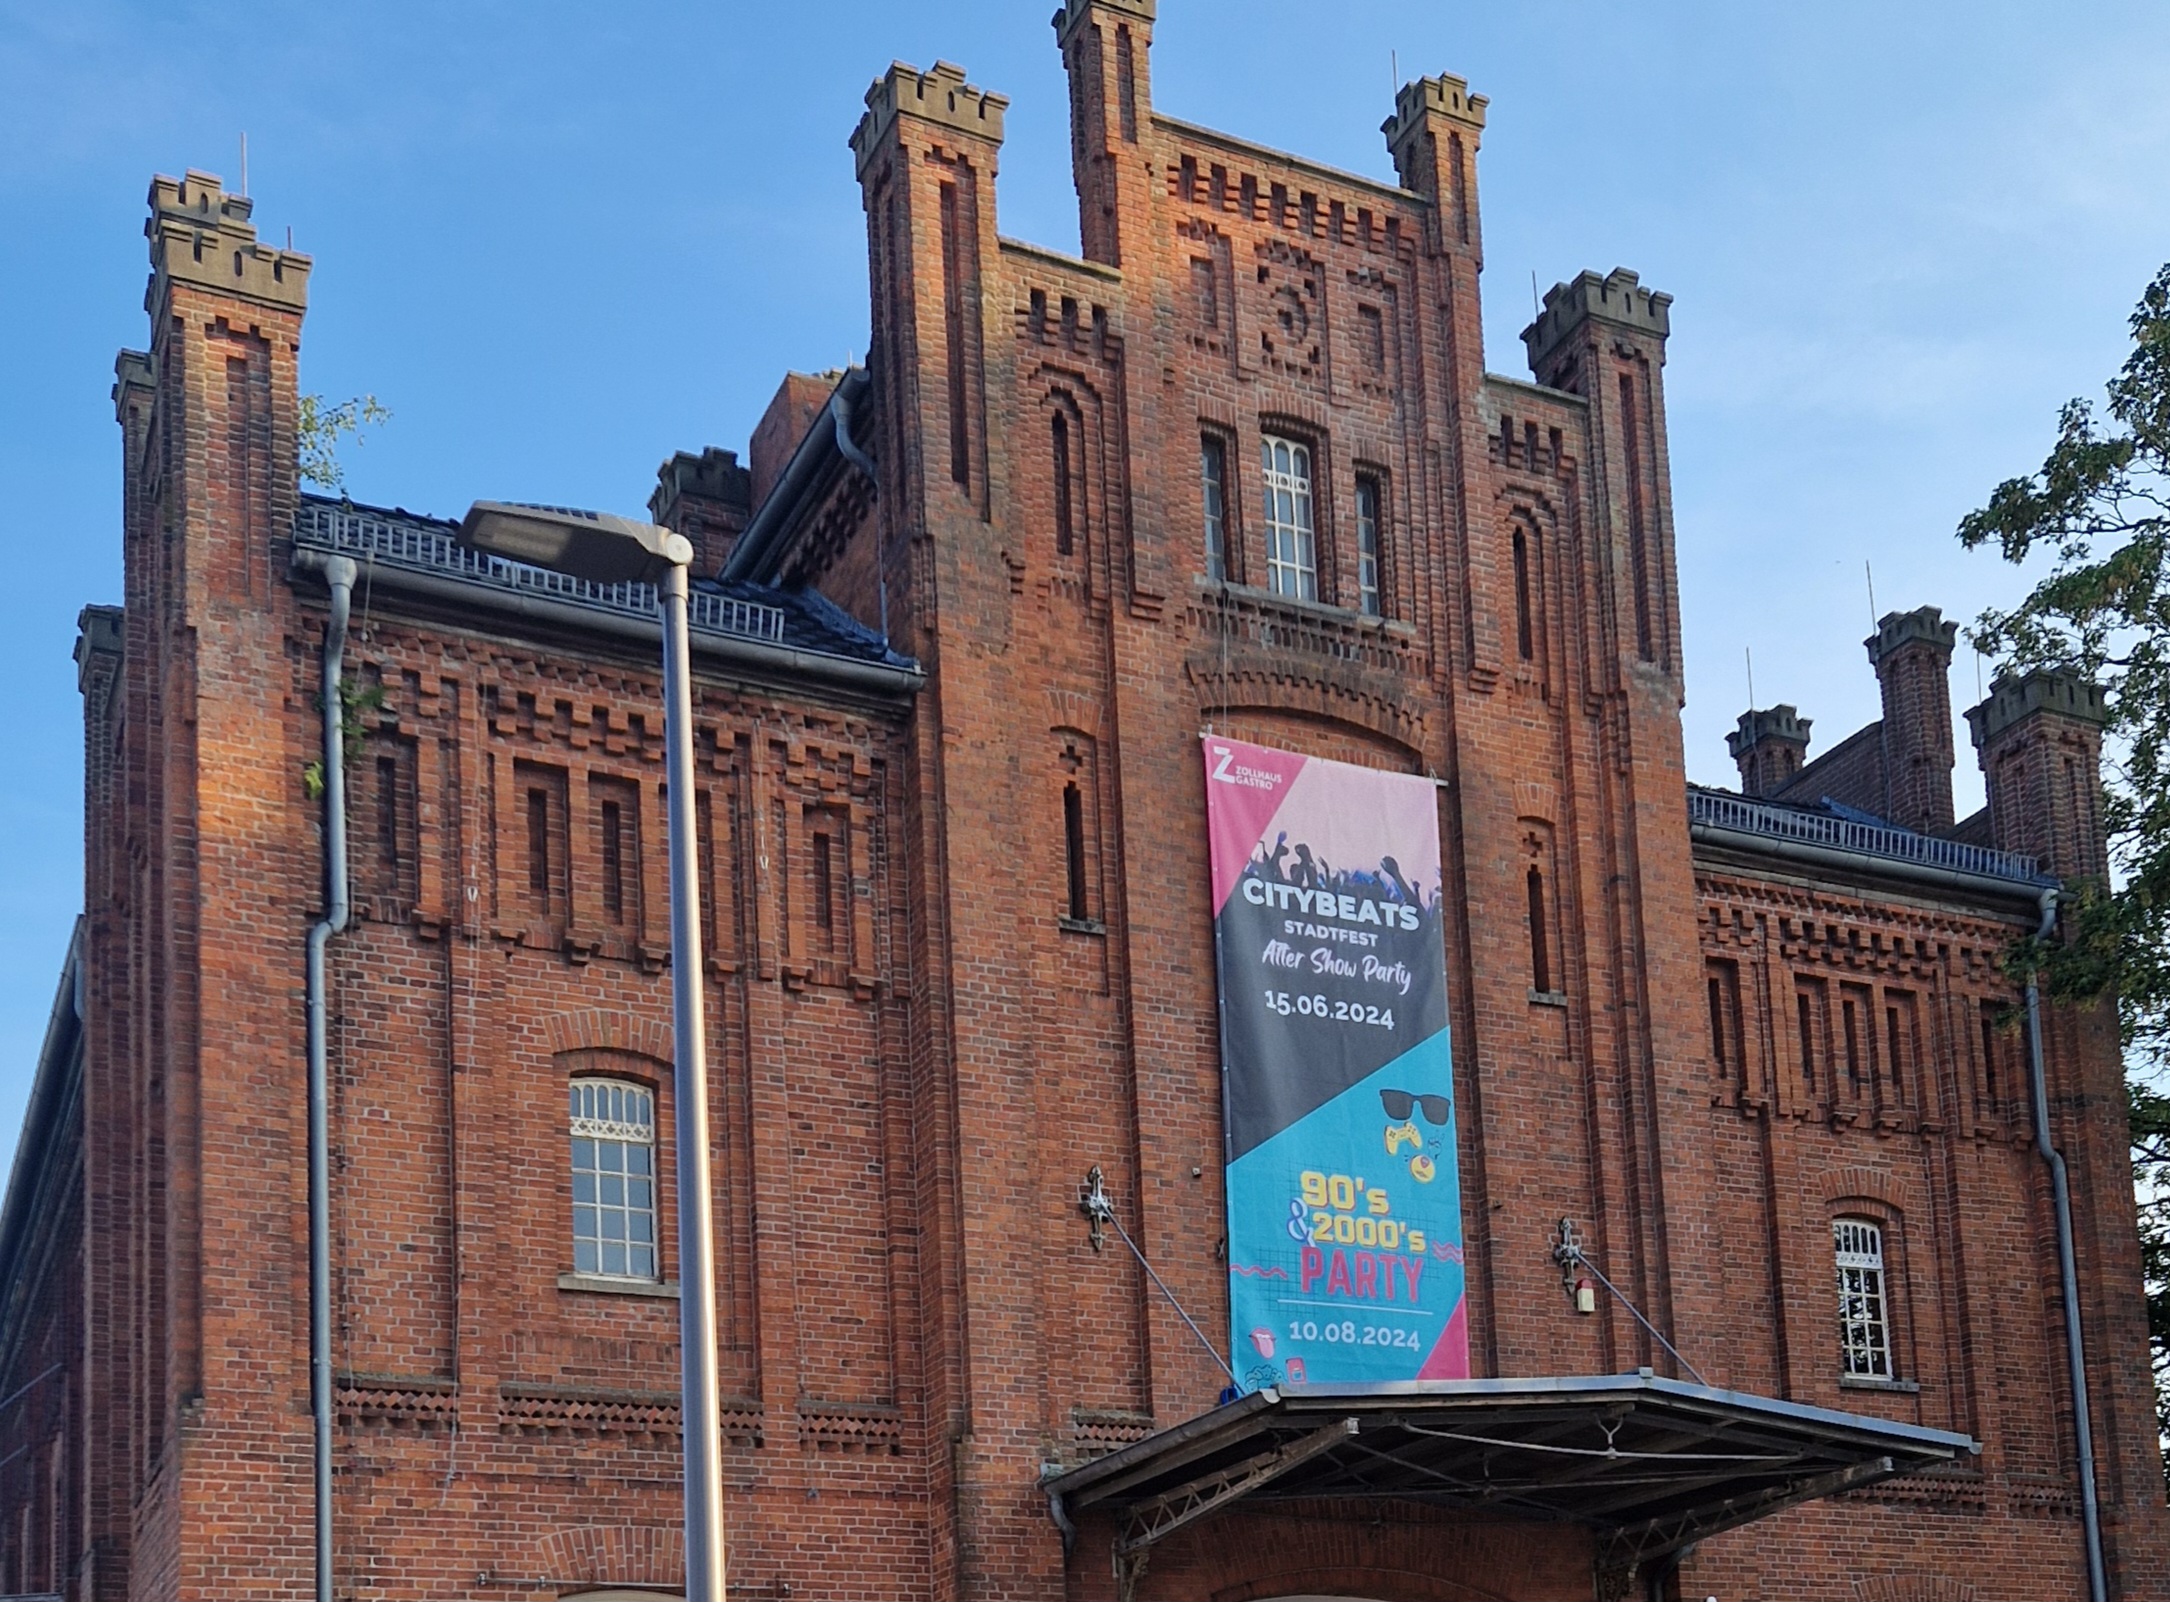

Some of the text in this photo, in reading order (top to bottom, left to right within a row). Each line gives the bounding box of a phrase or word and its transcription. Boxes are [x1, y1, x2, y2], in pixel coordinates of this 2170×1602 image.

[1213, 746, 1235, 783] Z
[1235, 765, 1282, 784] ZOLLHAUS
[1235, 774, 1273, 791] GASTRO
[1242, 878, 1420, 931] CITYBEATS
[1284, 920, 1378, 947] STADTFEST
[1261, 938, 1412, 996] After Show Party
[1264, 989, 1395, 1031] 15.06.2024
[1301, 1170, 1390, 1215] 90's
[1286, 1197, 1427, 1253] & 2000's
[1300, 1245, 1424, 1304] PARTY
[1289, 1321, 1421, 1352] 10.08.2024
